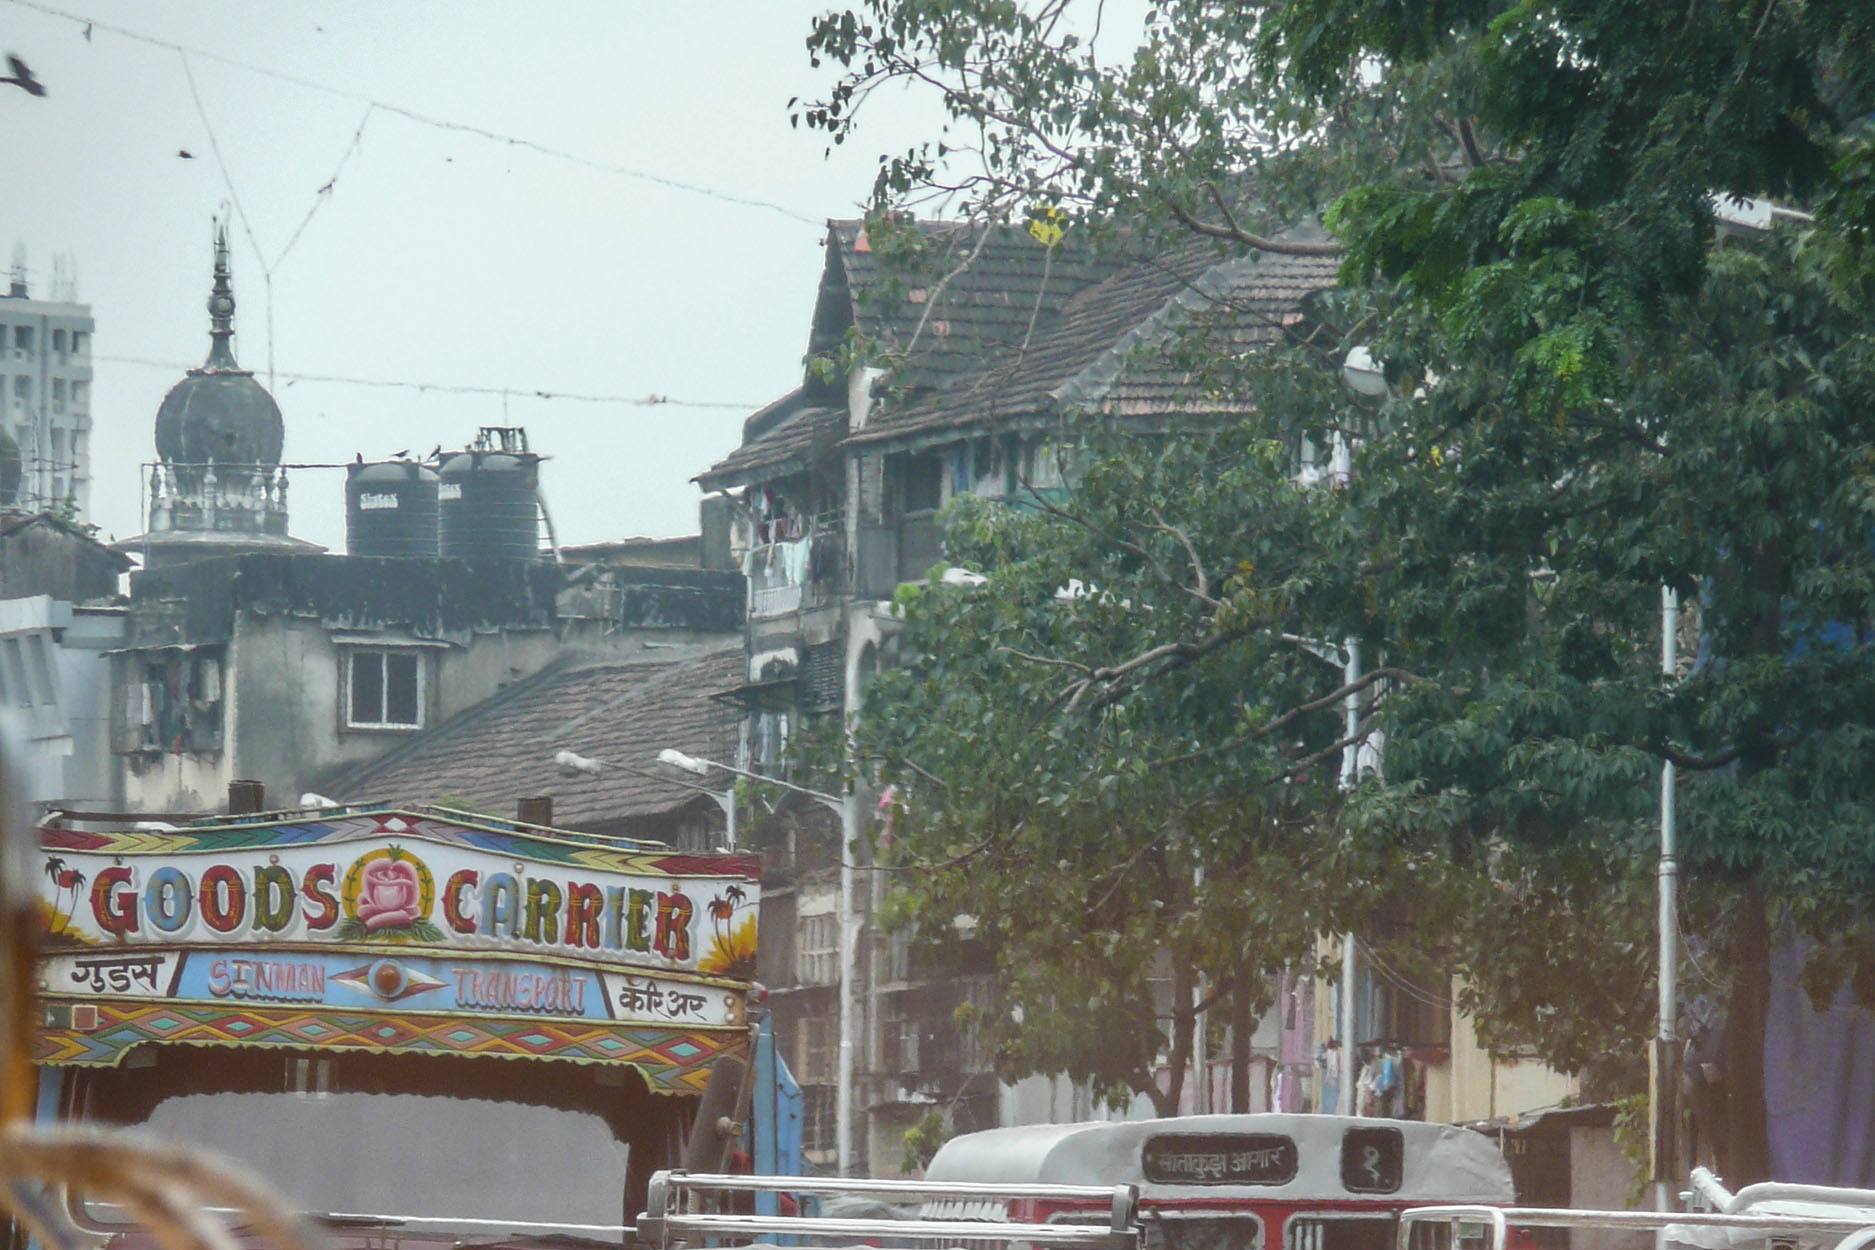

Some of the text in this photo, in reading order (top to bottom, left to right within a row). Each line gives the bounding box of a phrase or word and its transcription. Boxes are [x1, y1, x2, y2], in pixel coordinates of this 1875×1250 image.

[89, 863, 694, 961] GOODS CARRIER
[452, 968, 588, 1014] TRANSPORT
